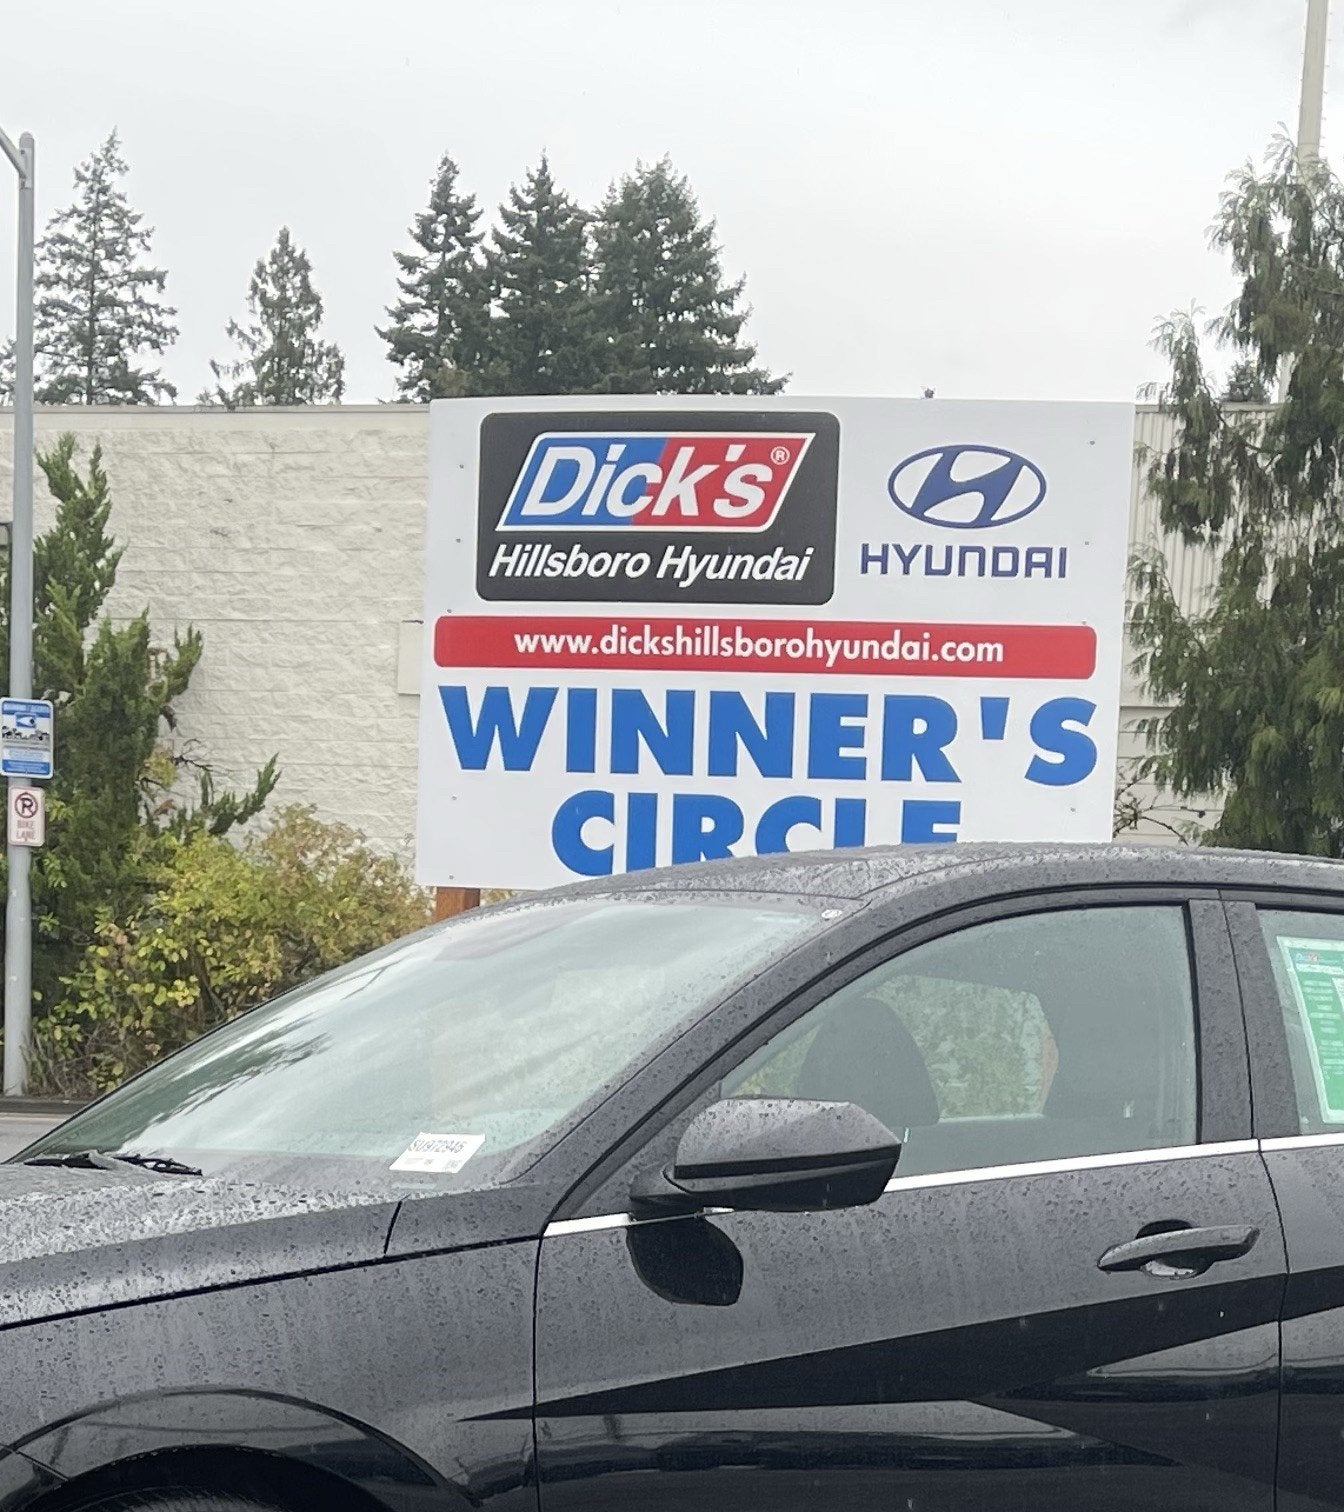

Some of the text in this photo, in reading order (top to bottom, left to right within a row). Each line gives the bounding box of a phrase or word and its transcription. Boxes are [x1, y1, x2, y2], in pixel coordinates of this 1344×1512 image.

[520, 443, 774, 518] Dick's
[488, 543, 815, 588] Hillsboro Hyundai
[860, 542, 1068, 579] HYUNDAI
[514, 628, 1005, 667] www.dickshillsborohyundai.com
[438, 684, 1099, 787] WINNER'S
